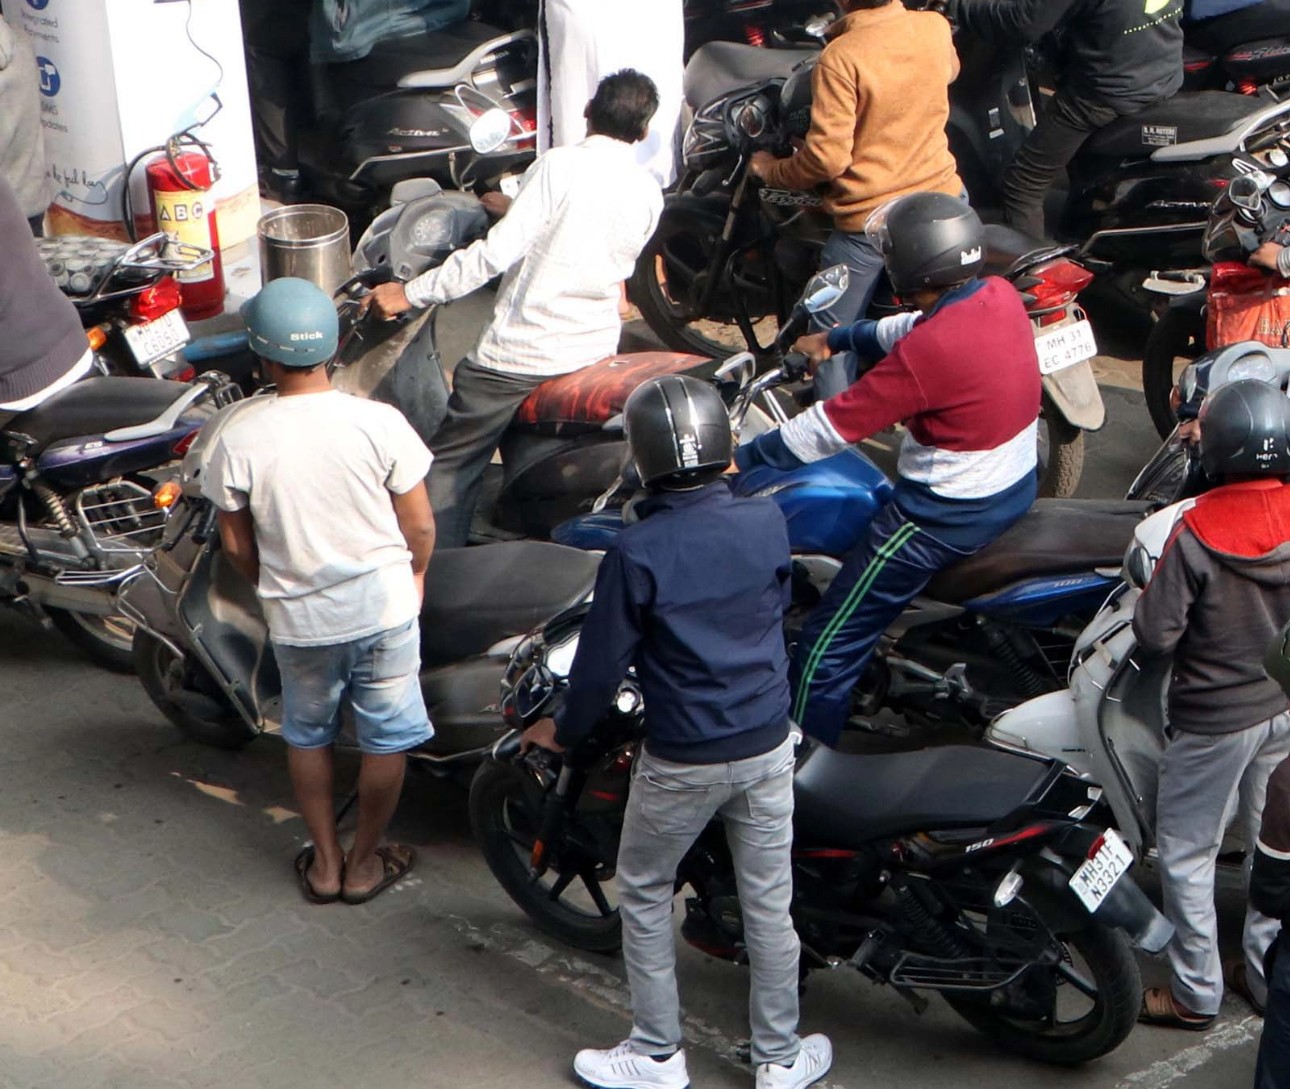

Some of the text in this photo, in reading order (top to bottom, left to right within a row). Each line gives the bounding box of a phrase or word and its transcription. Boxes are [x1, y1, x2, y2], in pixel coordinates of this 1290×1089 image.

[40, 118, 68, 133] pdates
[290, 331, 323, 341] Stick
[1047, 335, 1065, 350] MH
[1044, 354, 1060, 369] EC
[965, 838, 994, 853] 150
